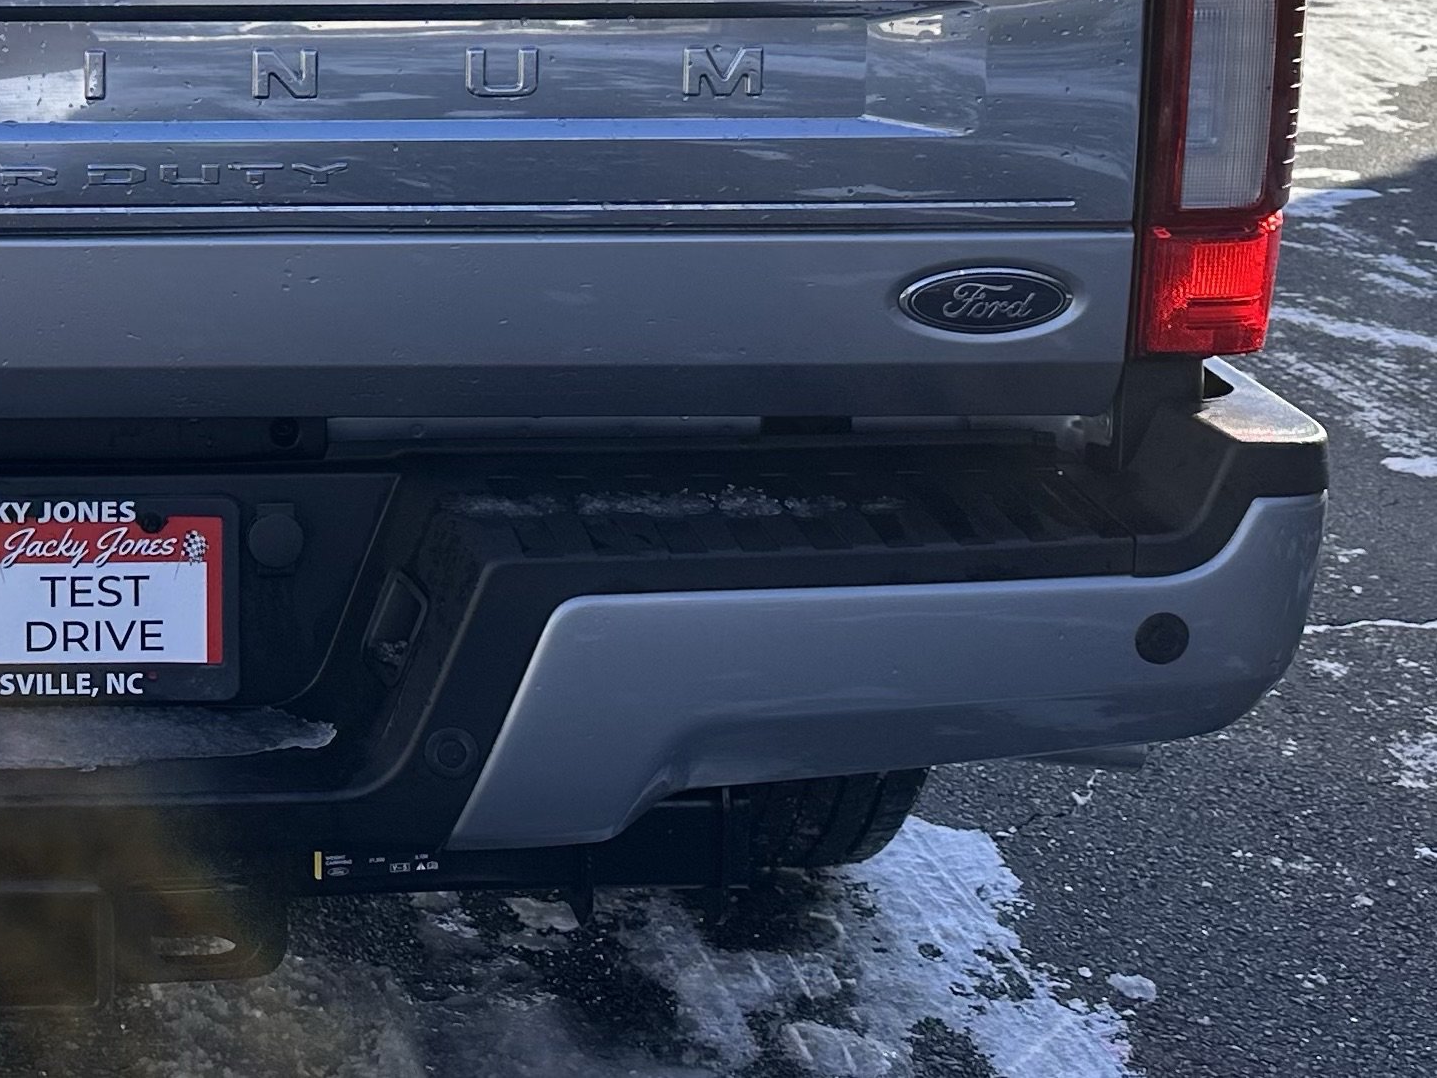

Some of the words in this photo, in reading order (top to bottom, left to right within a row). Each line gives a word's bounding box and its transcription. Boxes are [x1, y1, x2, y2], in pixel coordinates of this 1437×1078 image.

[86, 161, 349, 186] DUTY
[942, 282, 1037, 319] Ford
[39, 500, 137, 524] JONES
[2, 528, 90, 569] Jacky
[91, 527, 178, 569] Jones
[39, 574, 151, 608] TEST
[26, 619, 165, 653] DRIVE
[106, 672, 144, 696] NC
